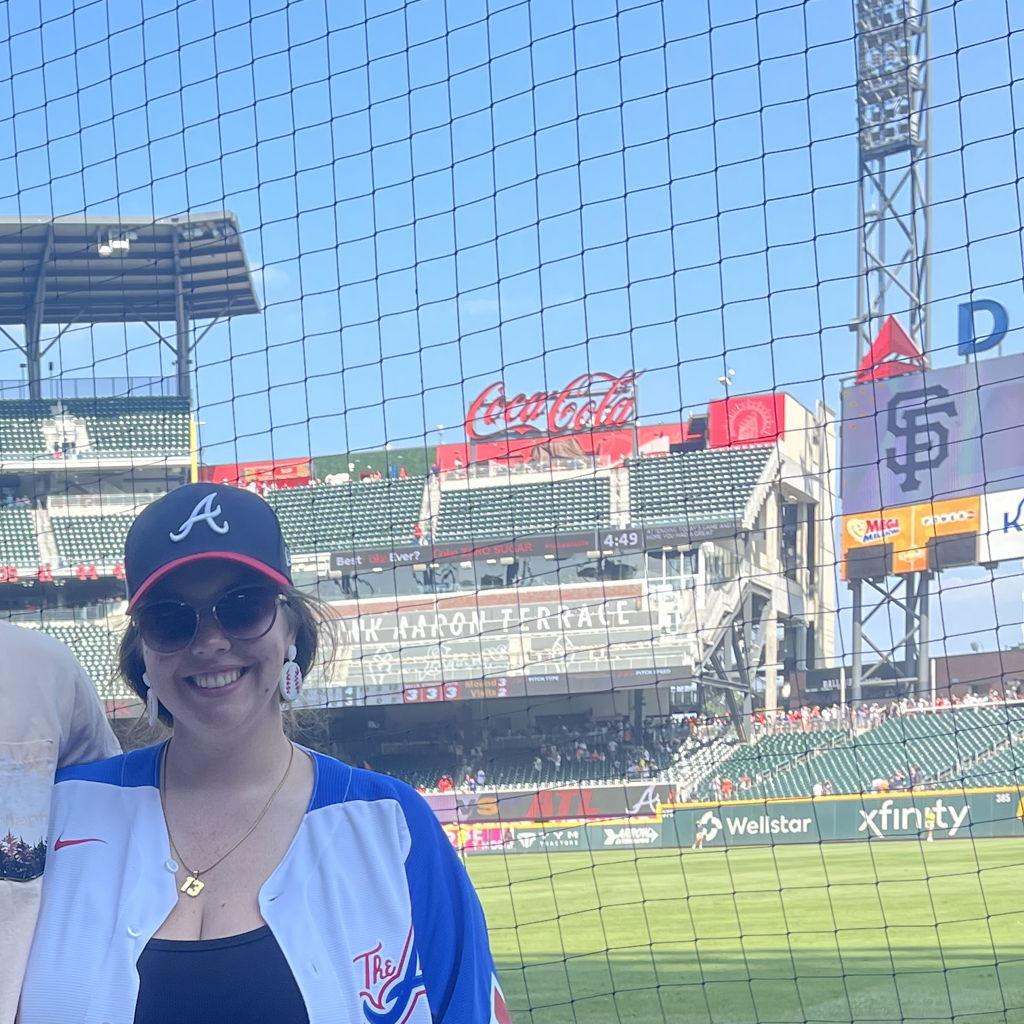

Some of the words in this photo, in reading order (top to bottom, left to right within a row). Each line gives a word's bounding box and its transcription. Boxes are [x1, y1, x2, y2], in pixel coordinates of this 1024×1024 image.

[169, 492, 229, 543] A
[603, 532, 639, 547] 4:49
[336, 555, 362, 566] Best
[389, 551, 421, 562] Ever?
[393, 611, 485, 641] AARON
[501, 600, 629, 633] TERRACE
[406, 689, 418, 700] 3
[426, 688, 437, 699] 3
[446, 687, 457, 698] 3
[526, 790, 599, 818] ATL
[626, 785, 661, 815] A
[726, 815, 812, 836] Wellstar
[180, 876, 205, 897] 13
[353, 941, 397, 990] The
